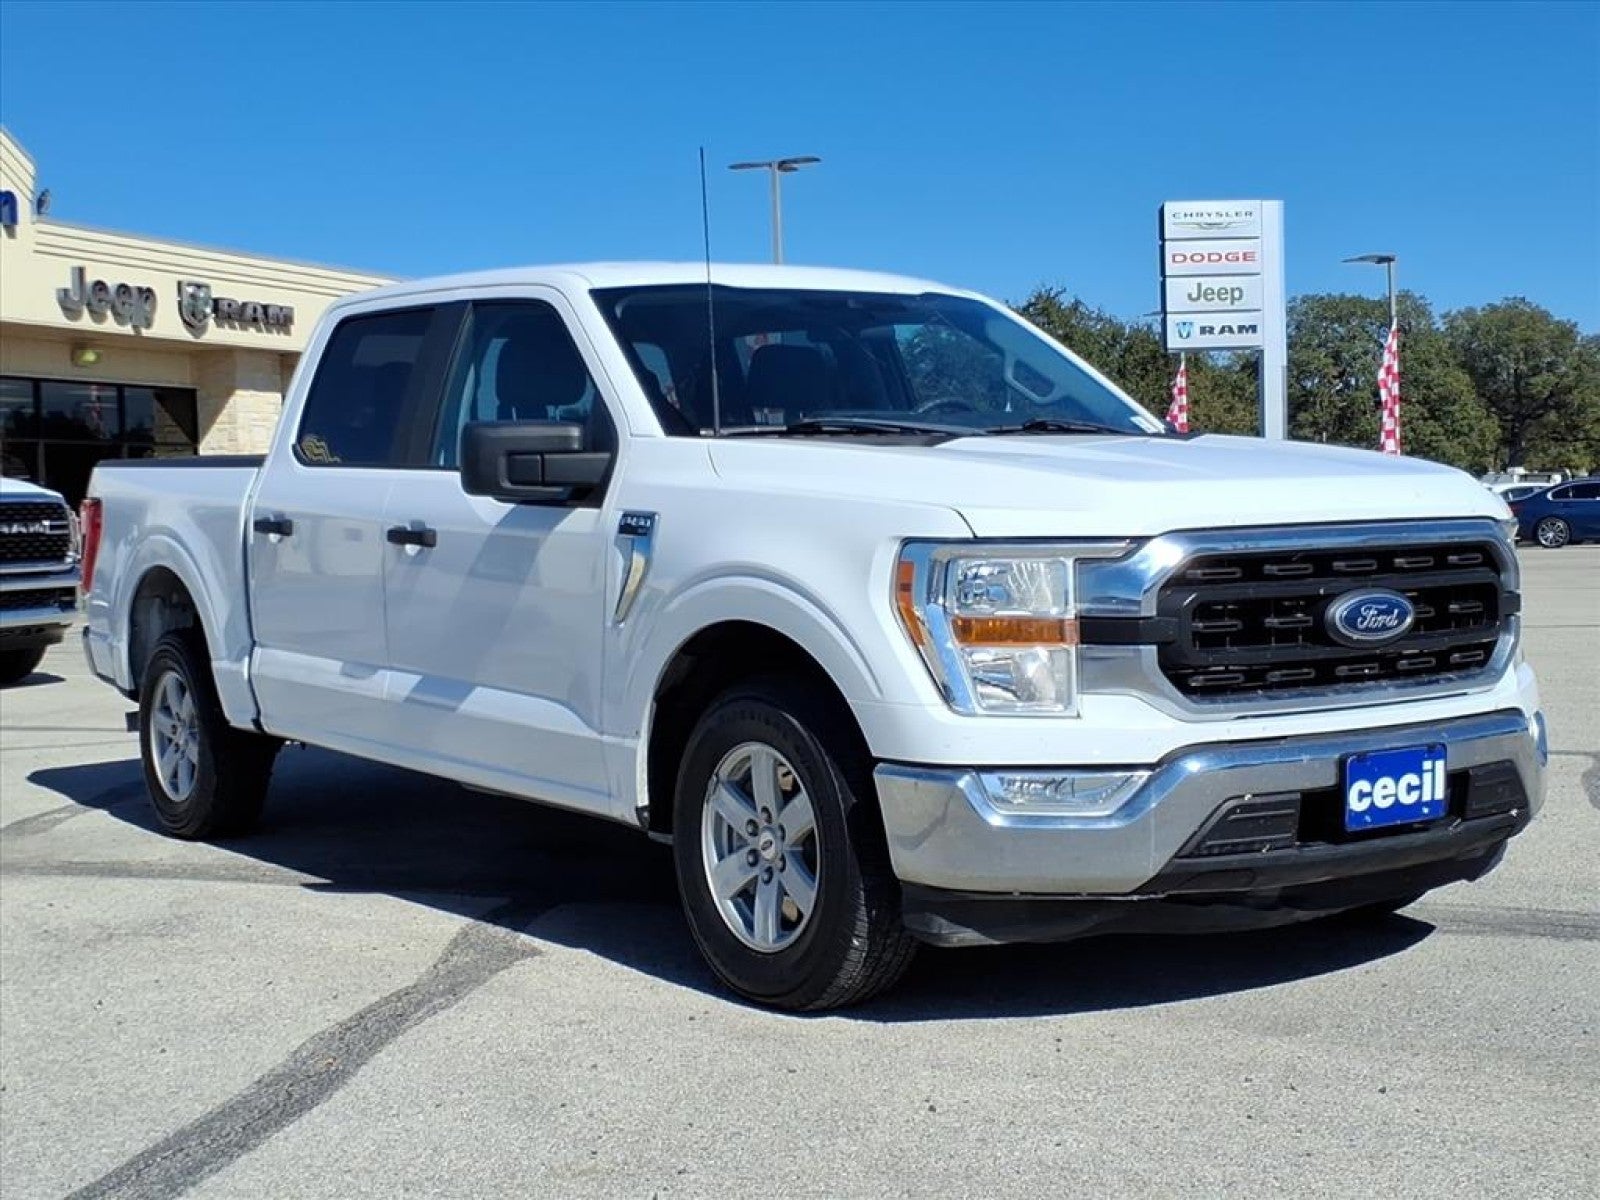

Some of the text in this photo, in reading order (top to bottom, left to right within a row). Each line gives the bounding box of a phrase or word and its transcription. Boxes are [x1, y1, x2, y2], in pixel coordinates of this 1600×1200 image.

[1172, 211, 1253, 219] CHRYSLER
[1171, 251, 1257, 264] DODGE
[56, 266, 156, 330] Jeep
[1187, 282, 1244, 306] Jeep
[212, 297, 295, 326] RAM
[1199, 324, 1258, 335] RAM
[1357, 604, 1399, 629] Ford
[1348, 759, 1446, 813] cecil
